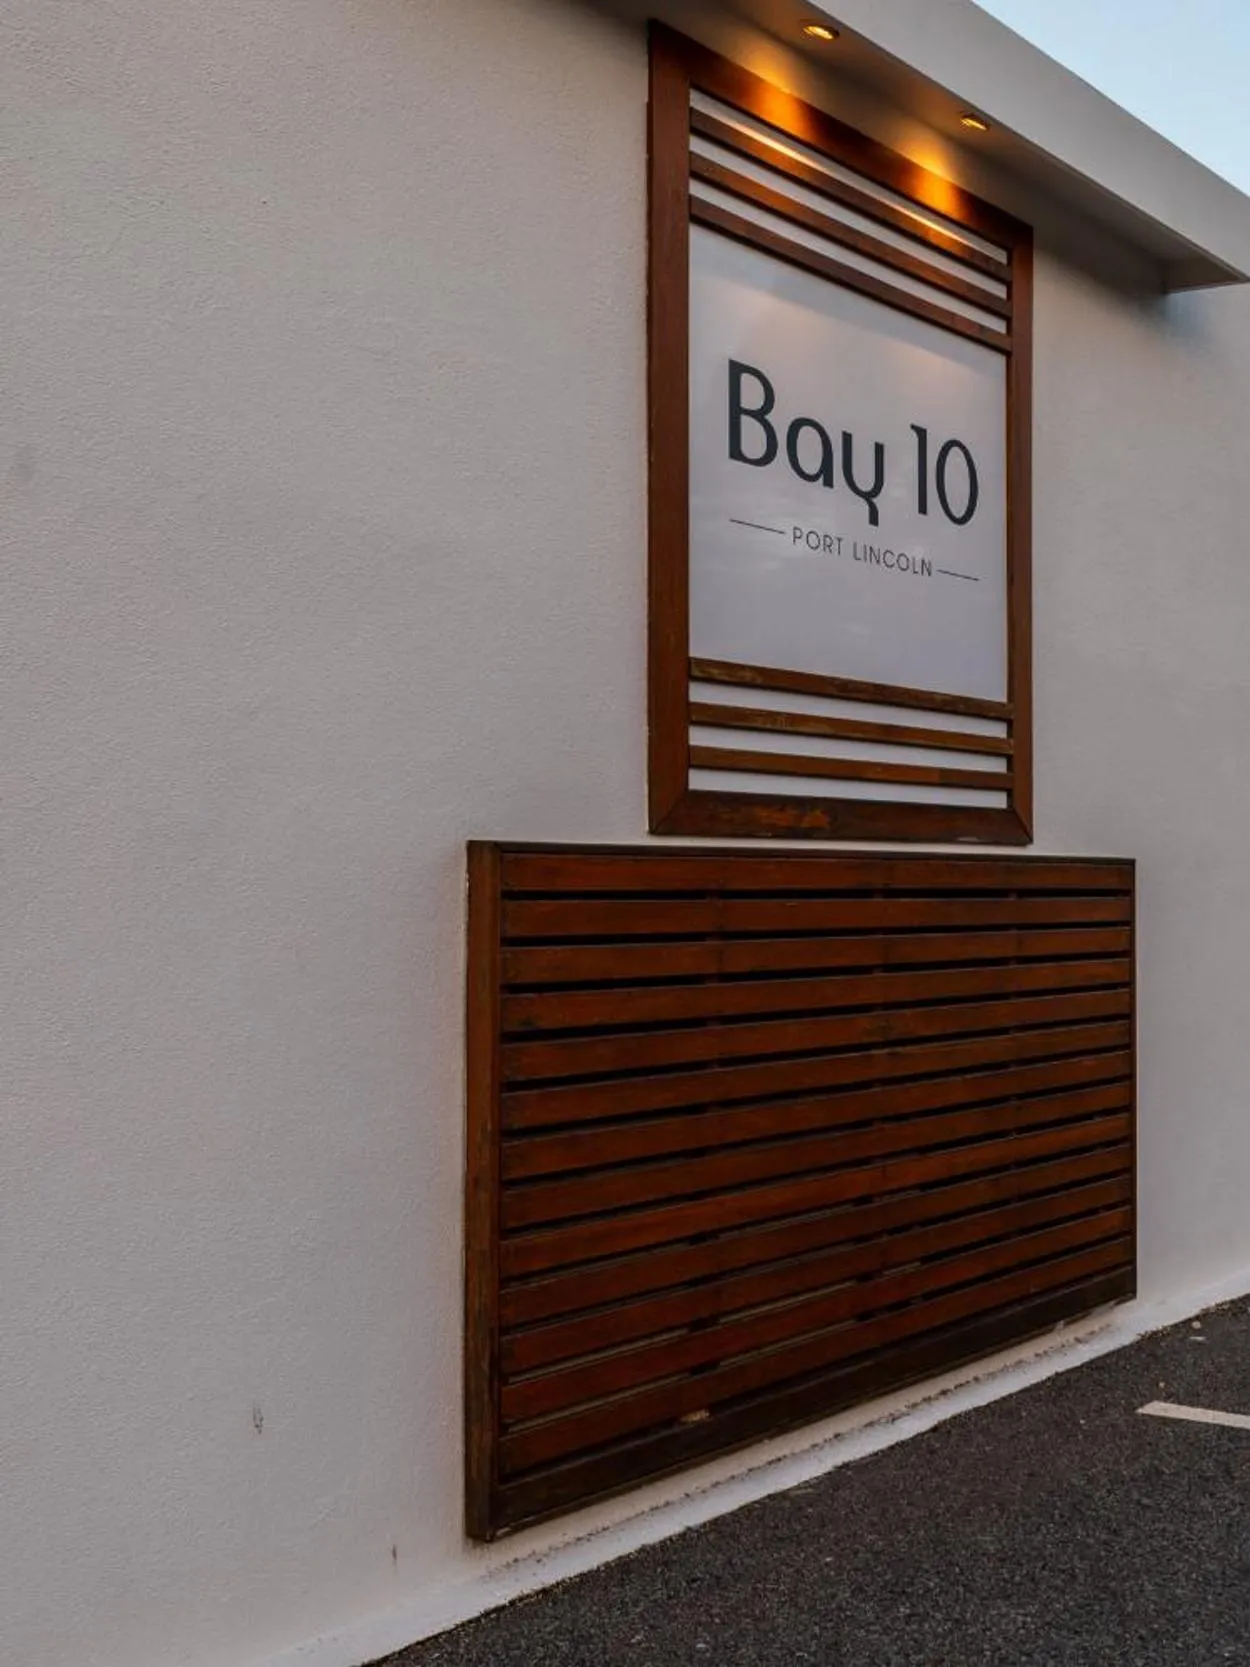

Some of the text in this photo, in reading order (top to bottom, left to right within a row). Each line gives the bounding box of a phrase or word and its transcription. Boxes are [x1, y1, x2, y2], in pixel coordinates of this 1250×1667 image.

[728, 359, 978, 526] Bay 10
[792, 526, 932, 577] PORT LINCOLN
